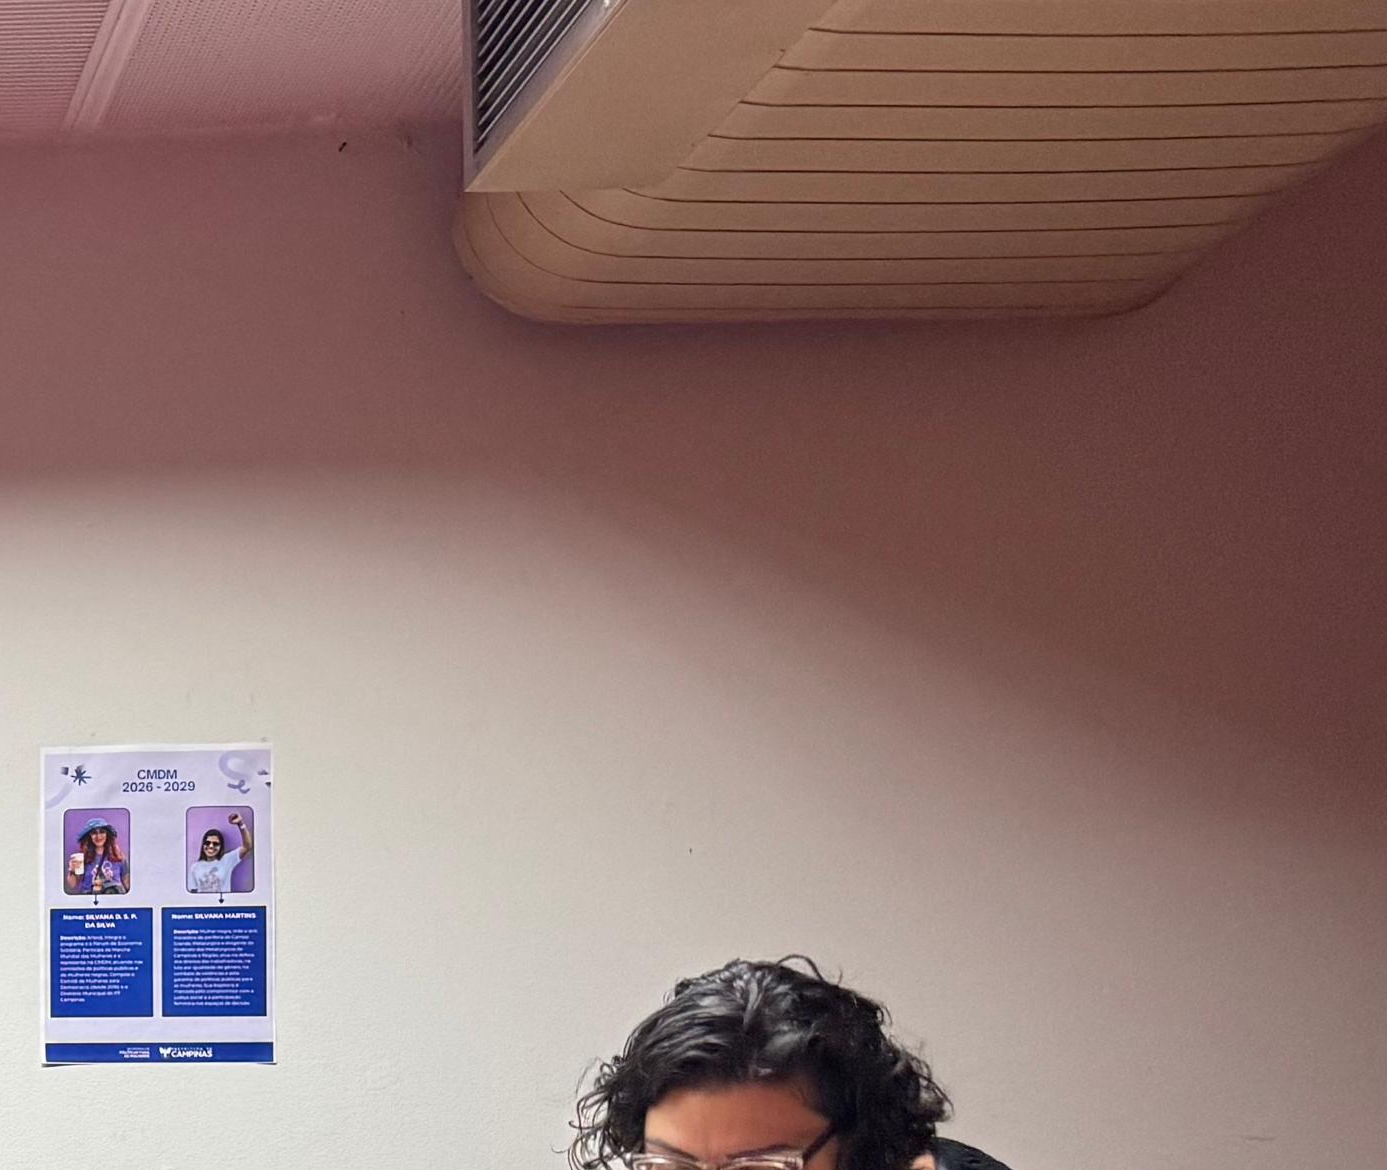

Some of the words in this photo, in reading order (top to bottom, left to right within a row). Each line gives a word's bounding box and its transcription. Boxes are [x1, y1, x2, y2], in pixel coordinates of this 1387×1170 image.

[137, 769, 177, 780] CMDM
[122, 782, 153, 792] 2026
[164, 781, 195, 791] 2029
[171, 1049, 212, 1058] CAMPINAS
